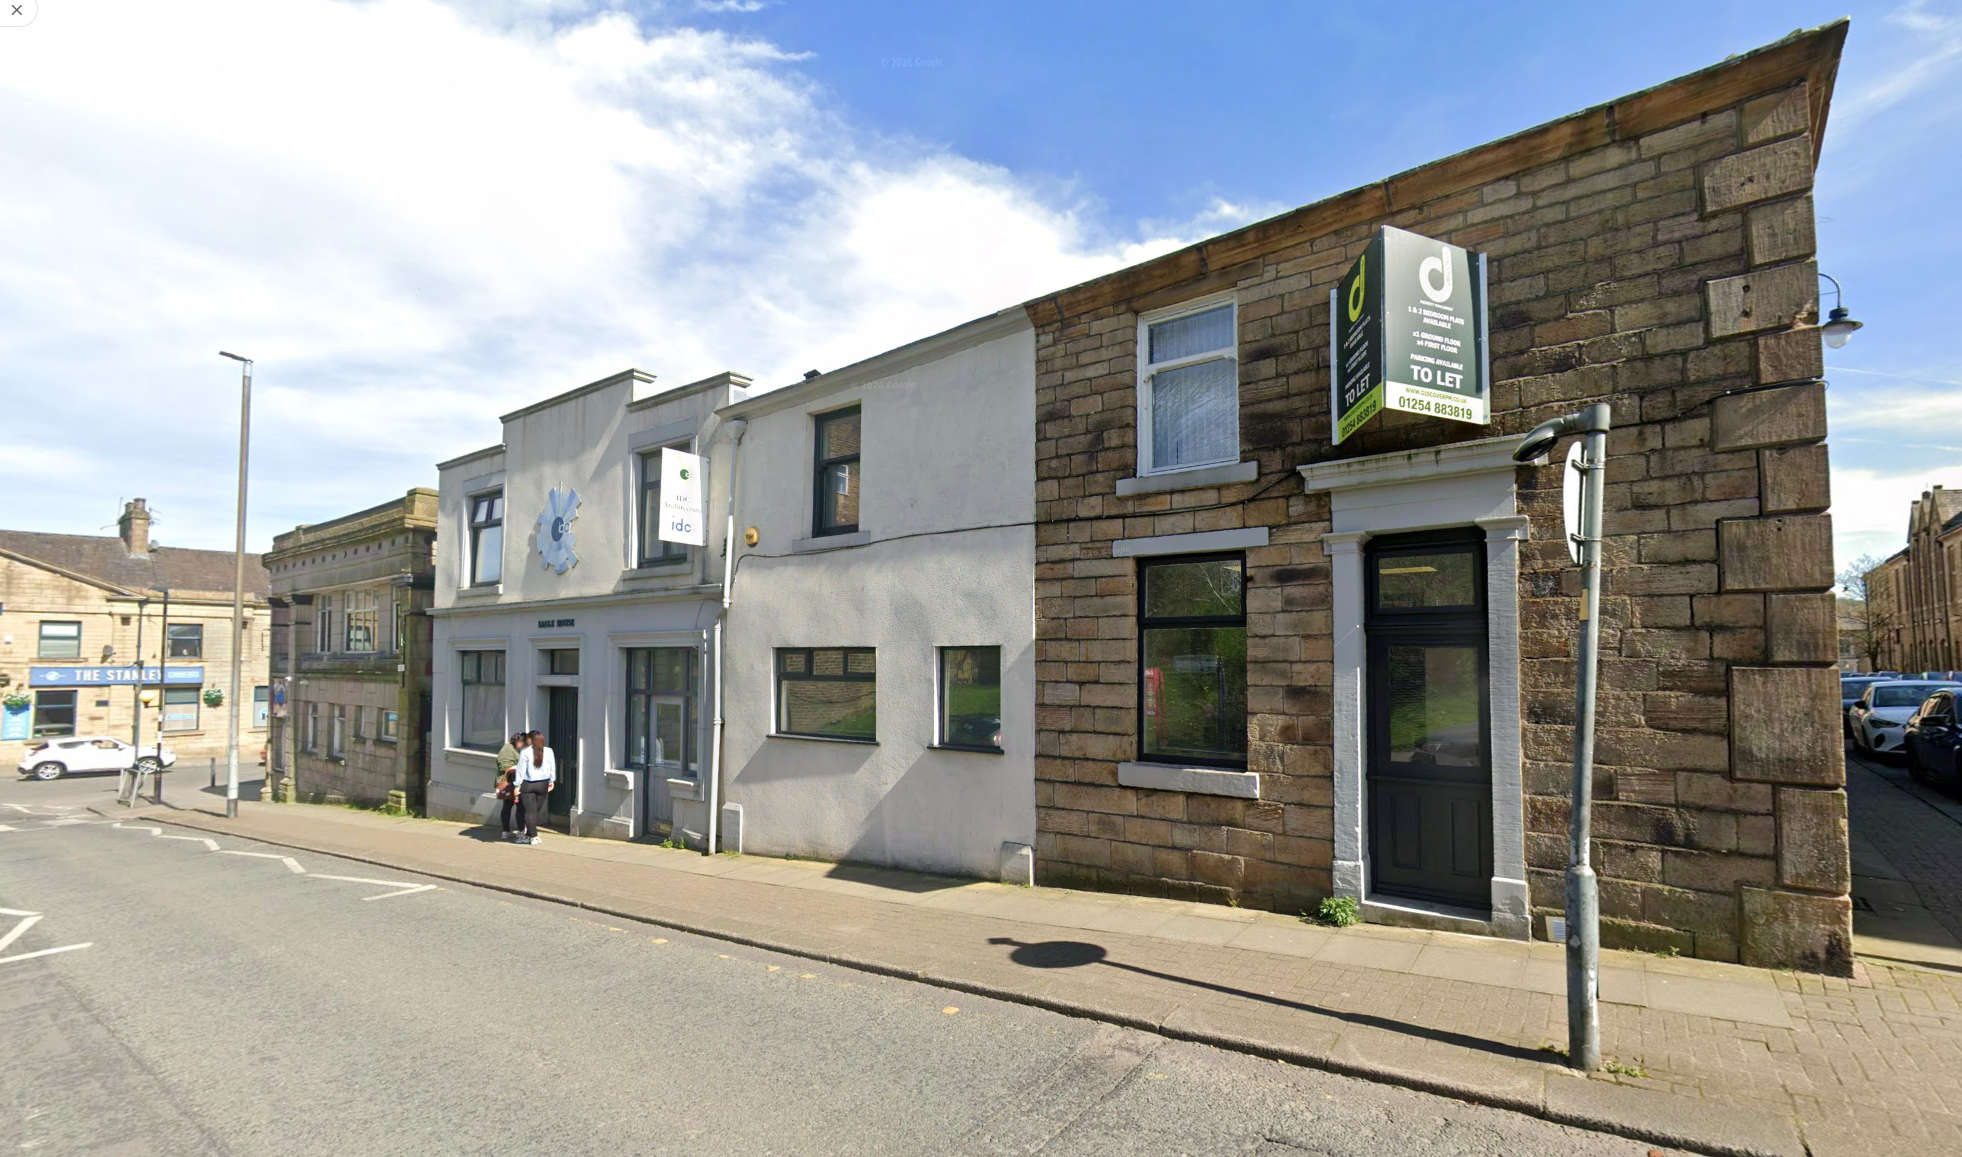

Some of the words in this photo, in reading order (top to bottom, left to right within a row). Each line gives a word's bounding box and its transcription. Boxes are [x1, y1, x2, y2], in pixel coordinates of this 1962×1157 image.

[1424, 340, 1440, 350] FIRST
[1440, 344, 1458, 354] FLOOR
[1444, 337, 1461, 347] FLOOR
[1410, 353, 1435, 364] PARKING
[1410, 365, 1432, 383] TO
[1437, 370, 1464, 389] LET
[1345, 388, 1355, 407] TO
[1356, 373, 1370, 398] LET
[1399, 396, 1431, 412] 01254
[1434, 402, 1473, 420] 883819
[671, 517, 692, 533] idc
[74, 669, 100, 681] THE
